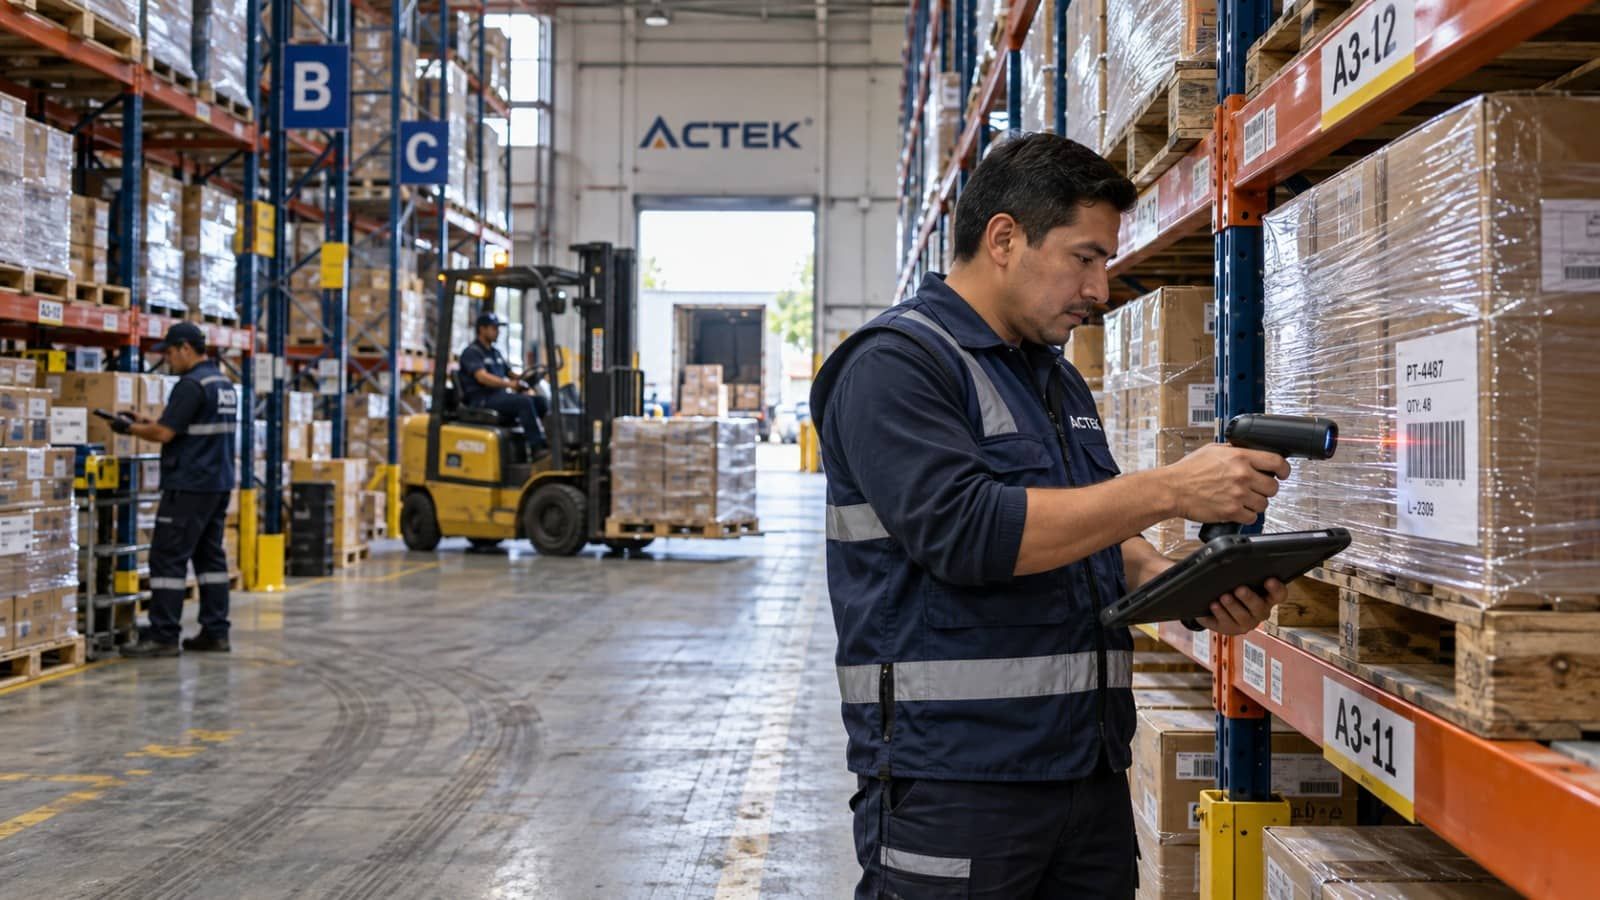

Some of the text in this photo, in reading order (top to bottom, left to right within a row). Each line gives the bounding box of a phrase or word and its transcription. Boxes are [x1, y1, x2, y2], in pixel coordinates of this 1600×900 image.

[1333, 3, 1396, 95] A3-12
[293, 61, 330, 111] B
[639, 114, 801, 149] ACTEK
[406, 132, 439, 173] C
[1406, 360, 1444, 382] PT-4487
[1423, 397, 1432, 412] 48
[1407, 500, 1434, 517] L-2309
[1335, 697, 1396, 778] A3-11
